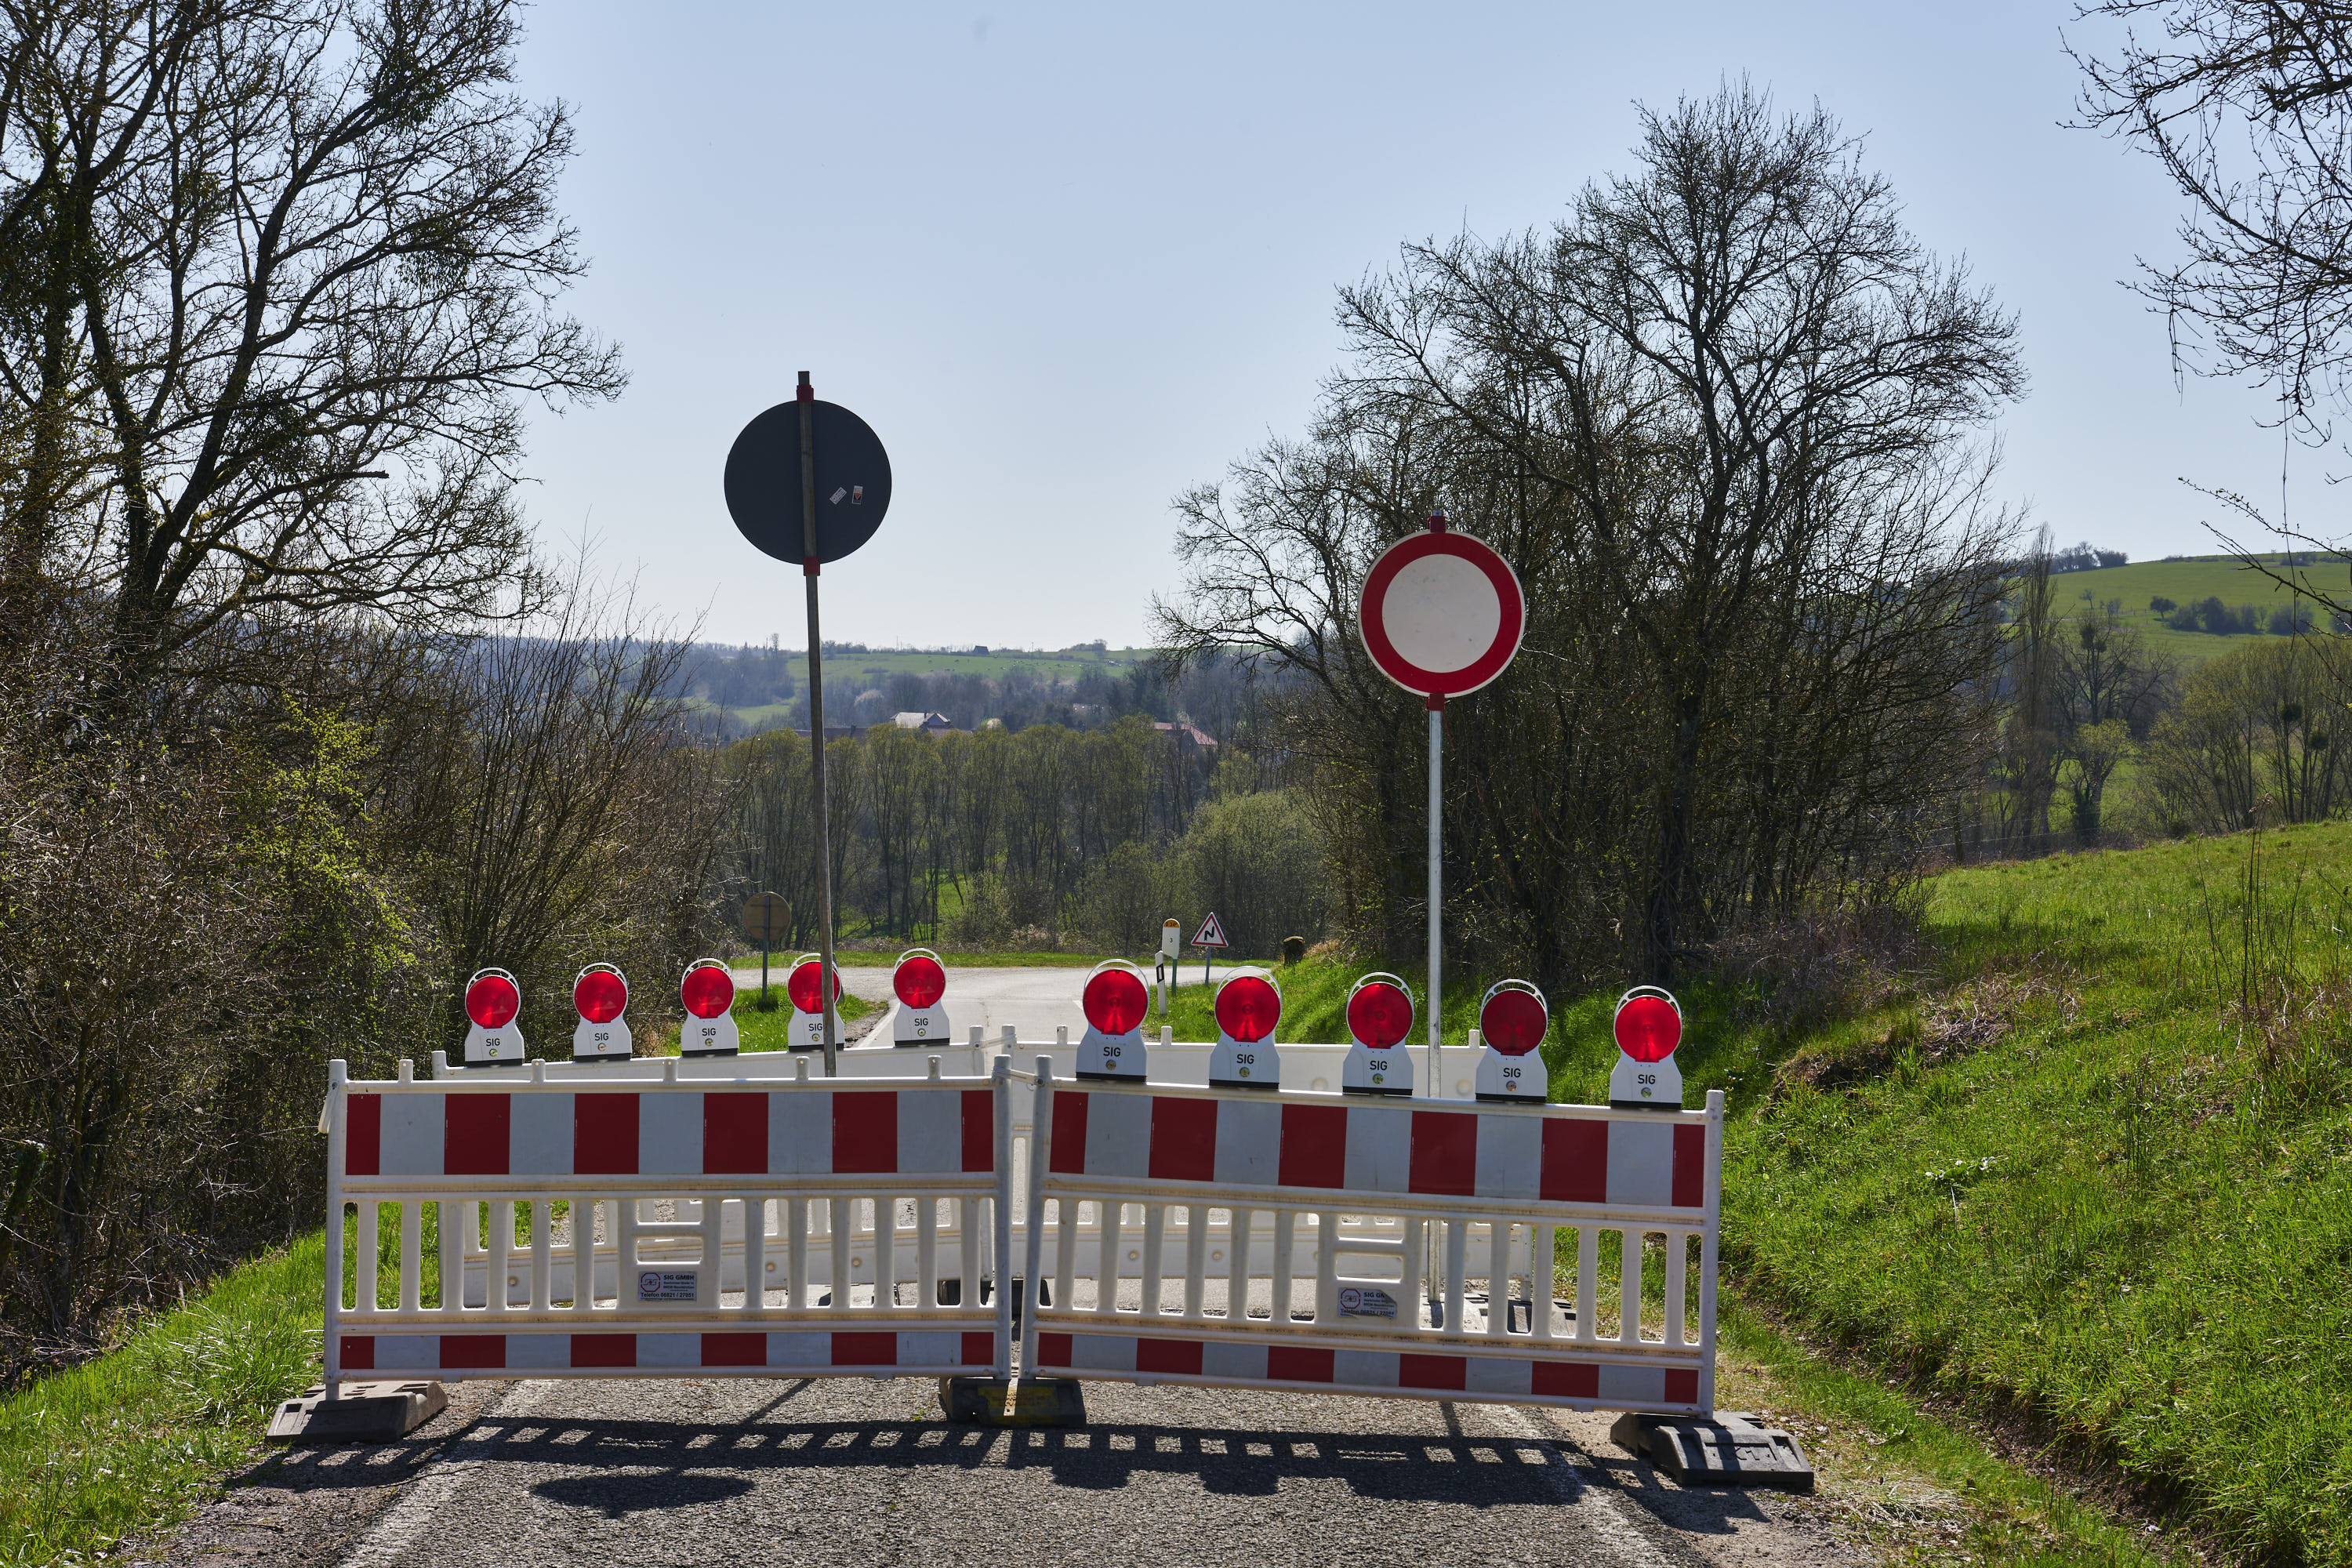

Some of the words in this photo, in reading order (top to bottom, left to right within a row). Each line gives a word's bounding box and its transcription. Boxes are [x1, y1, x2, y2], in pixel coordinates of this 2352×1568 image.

[808, 1022, 823, 1032] SIG
[914, 1018, 929, 1026] SIG
[702, 1027, 717, 1036] SIG
[485, 1037, 500, 1047] SIG
[594, 1033, 609, 1041] SIG
[1102, 1046, 1121, 1058] SIG
[1236, 1054, 1254, 1065] SIG
[1369, 1060, 1388, 1071] SIG
[1503, 1067, 1521, 1078] SIG
[1637, 1073, 1656, 1085] SIG
